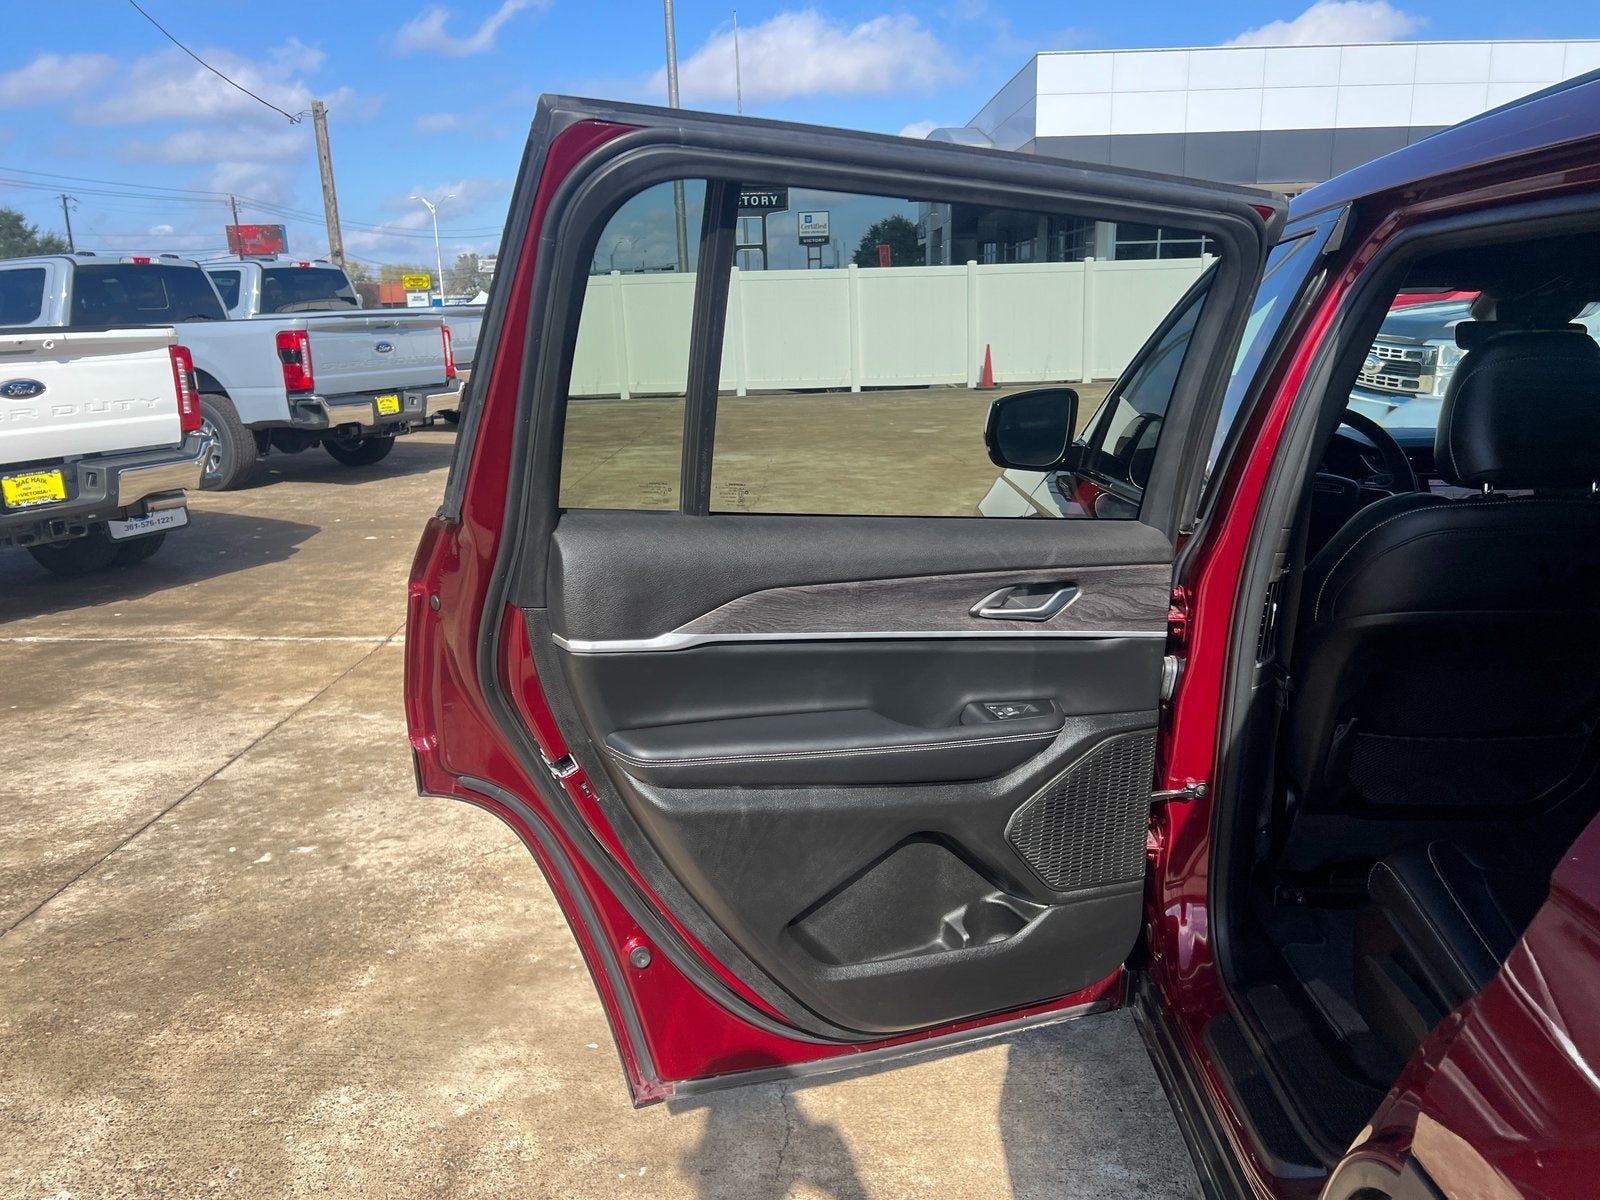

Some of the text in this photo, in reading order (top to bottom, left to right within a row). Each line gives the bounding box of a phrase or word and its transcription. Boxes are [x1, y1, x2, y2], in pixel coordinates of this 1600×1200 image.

[8, 383, 36, 395] Ford
[51, 397, 161, 417] DUTY
[16, 478, 30, 488] MAC
[124, 516, 174, 531] 361-576-1221
